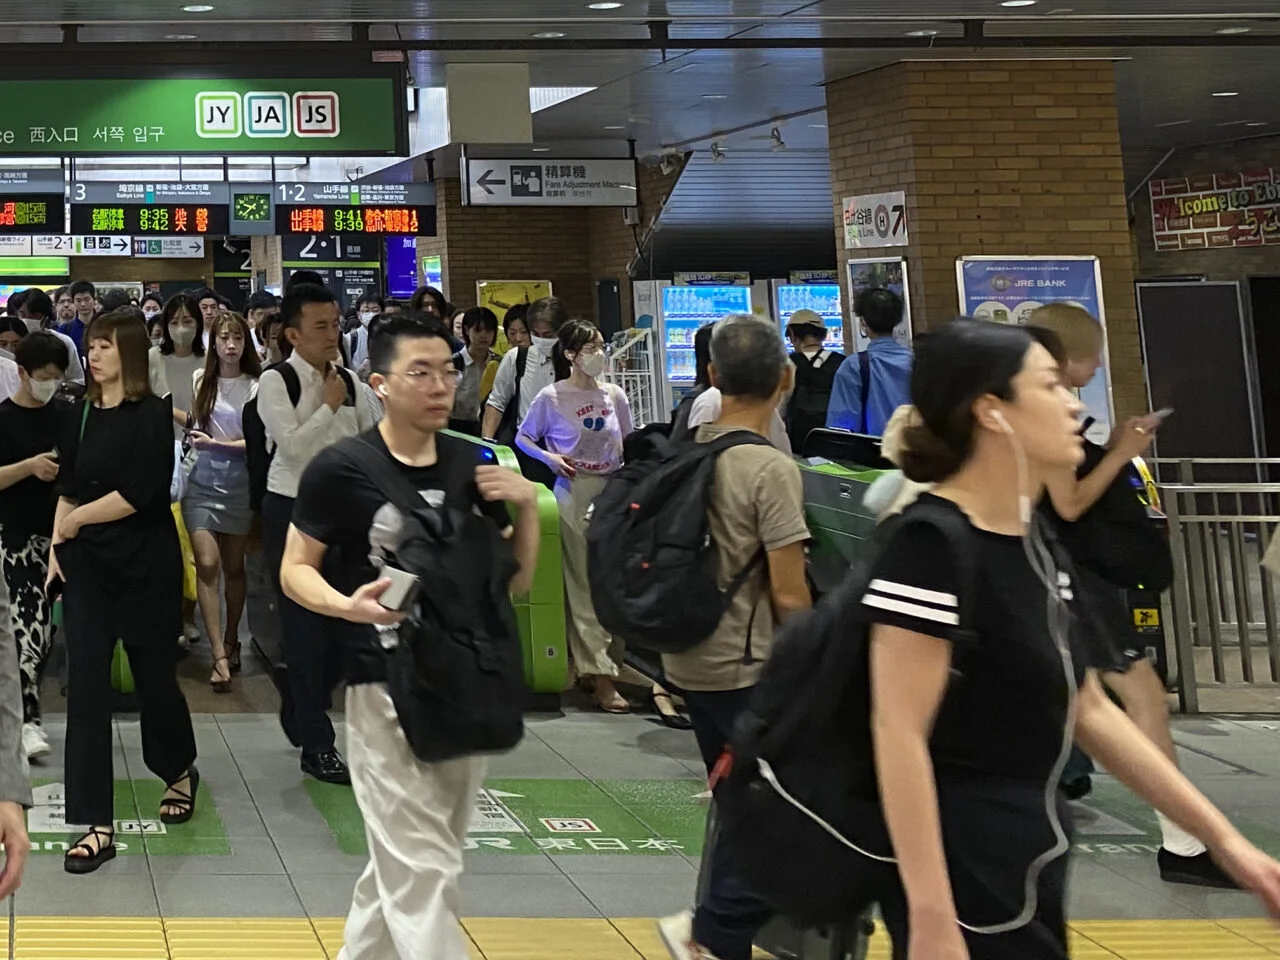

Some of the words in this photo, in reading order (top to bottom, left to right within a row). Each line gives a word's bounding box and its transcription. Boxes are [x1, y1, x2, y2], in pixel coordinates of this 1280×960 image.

[206, 106, 230, 123] JY
[254, 106, 280, 123] JA
[305, 105, 327, 123] JS
[29, 127, 78, 143] 西入口
[93, 126, 124, 142] 서쪽
[133, 126, 165, 142] 입구
[545, 165, 586, 179] 精算機
[75, 184, 86, 200] 3
[323, 185, 349, 193] 山手線
[563, 181, 601, 189] Adjustment
[140, 209, 168, 219] 9:35
[335, 210, 361, 220] 9:41
[140, 220, 168, 230] 9:42
[335, 221, 363, 231] 9:39
[1014, 279, 1034, 287] JRE
[1037, 279, 1066, 287] BANK
[534, 837, 684, 851] 東日本
